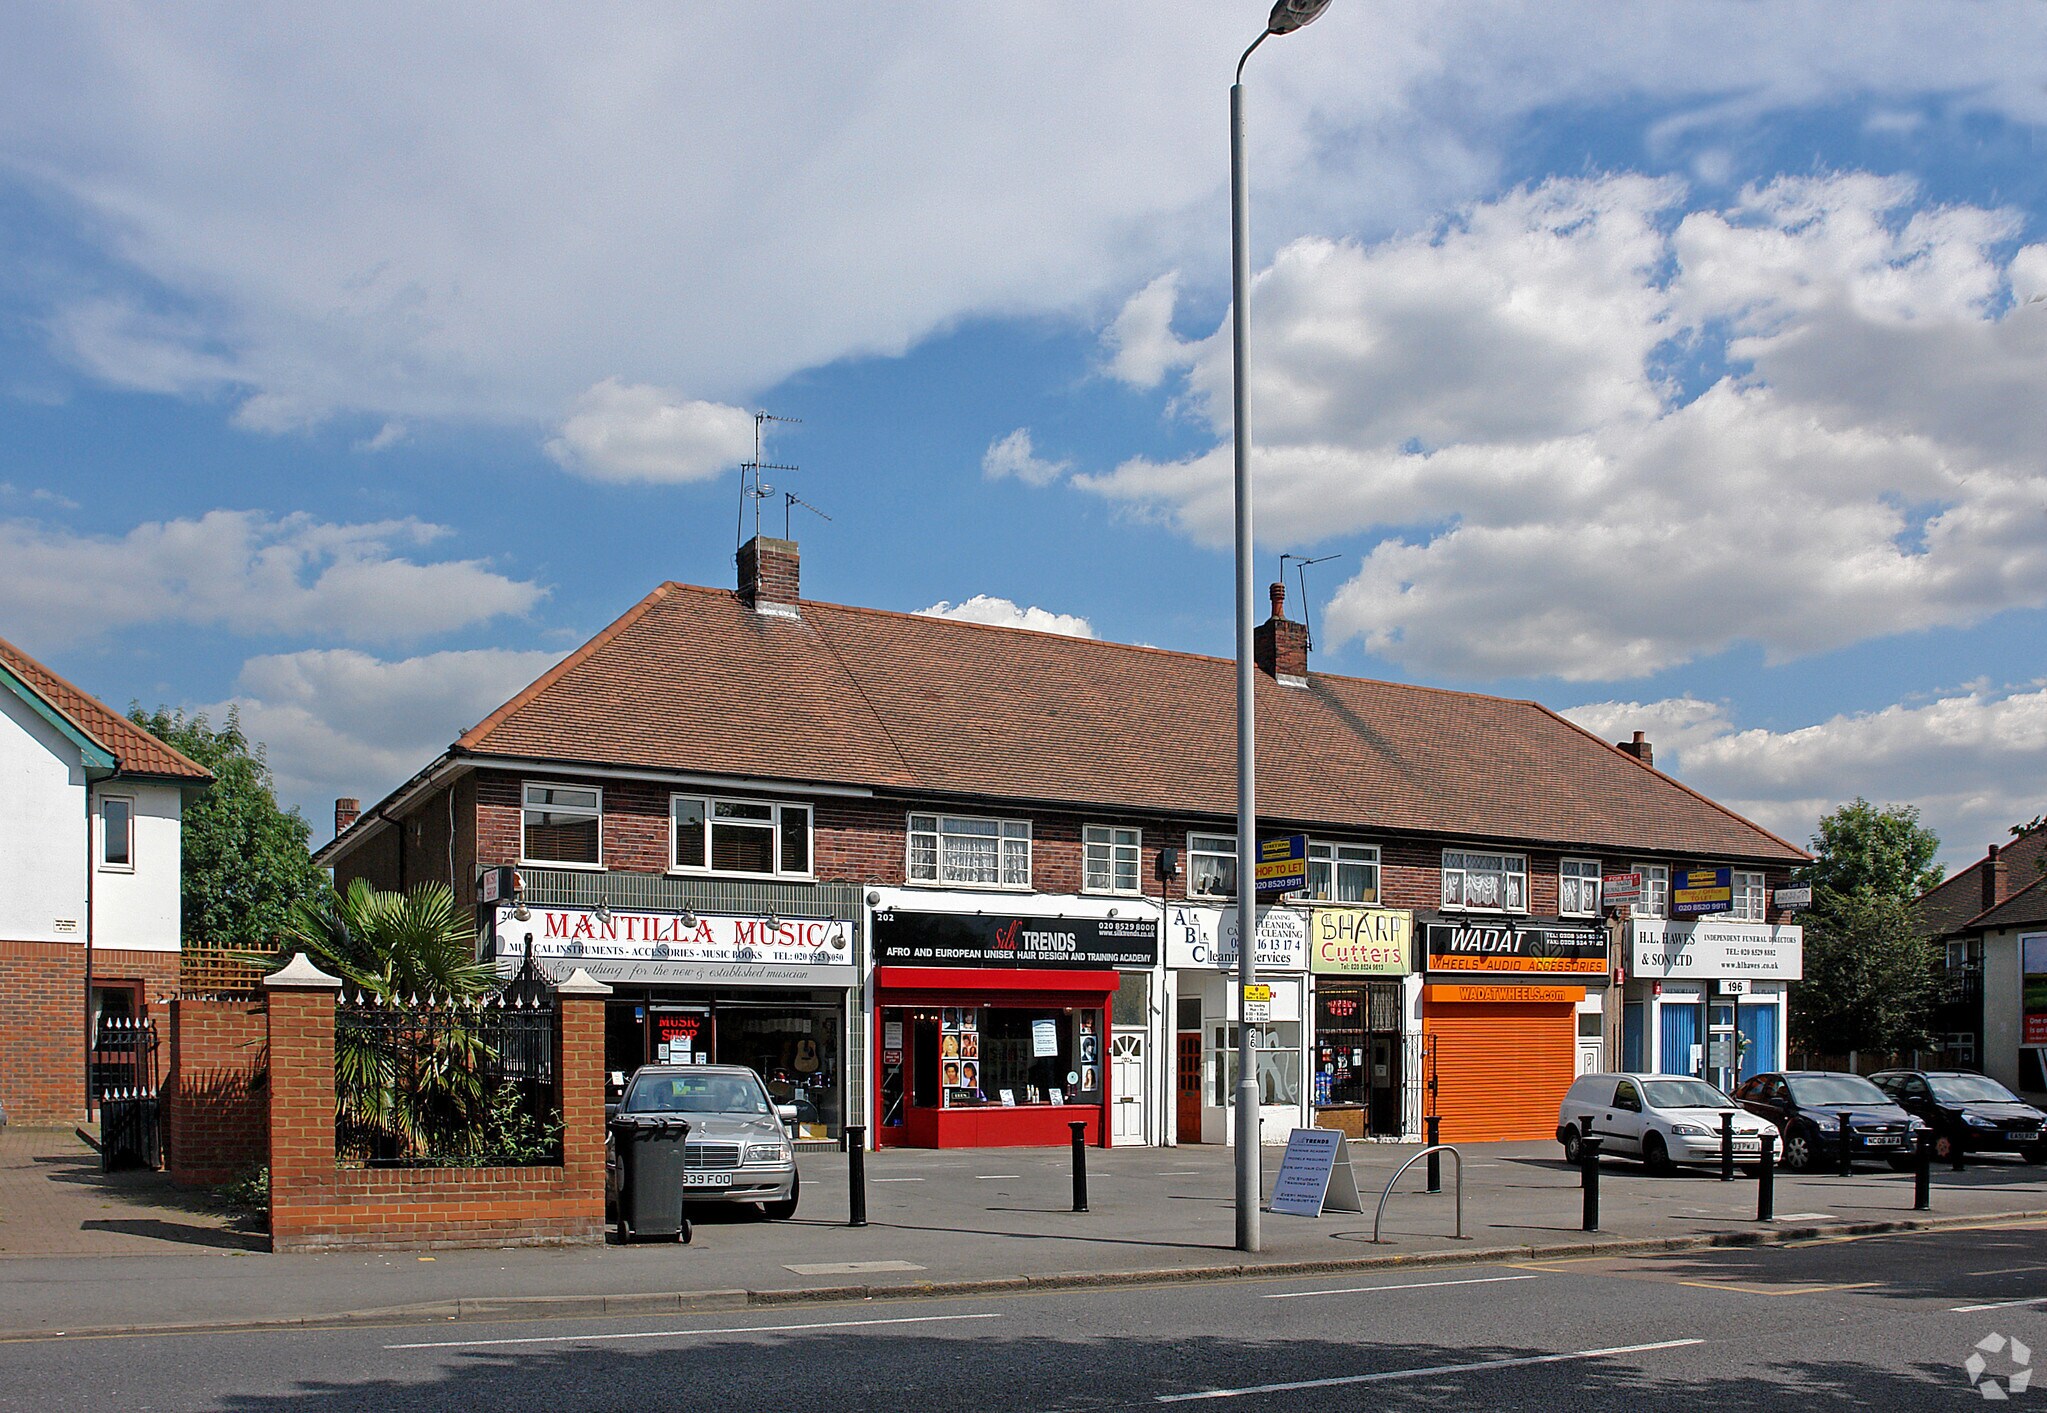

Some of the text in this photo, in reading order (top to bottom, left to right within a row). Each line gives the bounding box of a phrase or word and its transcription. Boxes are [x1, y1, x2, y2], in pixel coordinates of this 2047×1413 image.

[1275, 865, 1286, 874] TO
[1288, 863, 1303, 873] LET
[1268, 880, 1286, 888] 8520
[1287, 878, 1302, 887] 9911
[1711, 902, 1727, 910] 9911
[1174, 909, 1187, 926] A
[1255, 920, 1296, 930] CLEANING
[544, 912, 826, 948] MANTILLA MUSIC
[1098, 922, 1114, 930] 020
[1115, 923, 1135, 931] 8529
[1261, 929, 1303, 939] CLEANING
[1321, 912, 1400, 943] SHARP
[992, 919, 1076, 952] Silk TRENDS
[1185, 927, 1196, 944] B
[1450, 928, 1527, 953] WADAT
[1639, 931, 1696, 946] H.L. HAWES
[1703, 934, 1797, 944] INDEPENDENT FUNERAL DIRECTORS
[556, 944, 624, 956] INSTRUMENTS
[631, 947, 695, 958] ACCESSORIES
[701, 949, 730, 959] MUSIC
[732, 951, 763, 960] BOOKS
[773, 951, 792, 961] TEL:
[794, 952, 807, 961] 020
[1257, 939, 1301, 951] 16 13 17 4
[1321, 942, 1401, 963] Cutters
[1725, 948, 1739, 956] TEL:
[1740, 948, 1750, 957] 020
[886, 947, 1152, 963] AFRO AND EUROPEAN UNISEX HAIR DESIGN AND TRAINING ACADEMY
[1641, 952, 1693, 967] & SON LTD
[629, 963, 647, 980] for
[653, 962, 670, 976] the
[672, 968, 694, 976] new
[696, 966, 704, 980] &
[709, 966, 765, 979] established
[766, 969, 808, 979] musician
[1432, 958, 1602, 973] WHEELS AUDIO ACCESSORIES
[1459, 986, 1566, 1001] WADATWHEELS.com
[1727, 981, 1743, 992] 196
[658, 1015, 700, 1027] MUSIC
[661, 1029, 698, 1042] SHOP
[707, 1174, 731, 1184] FOO
